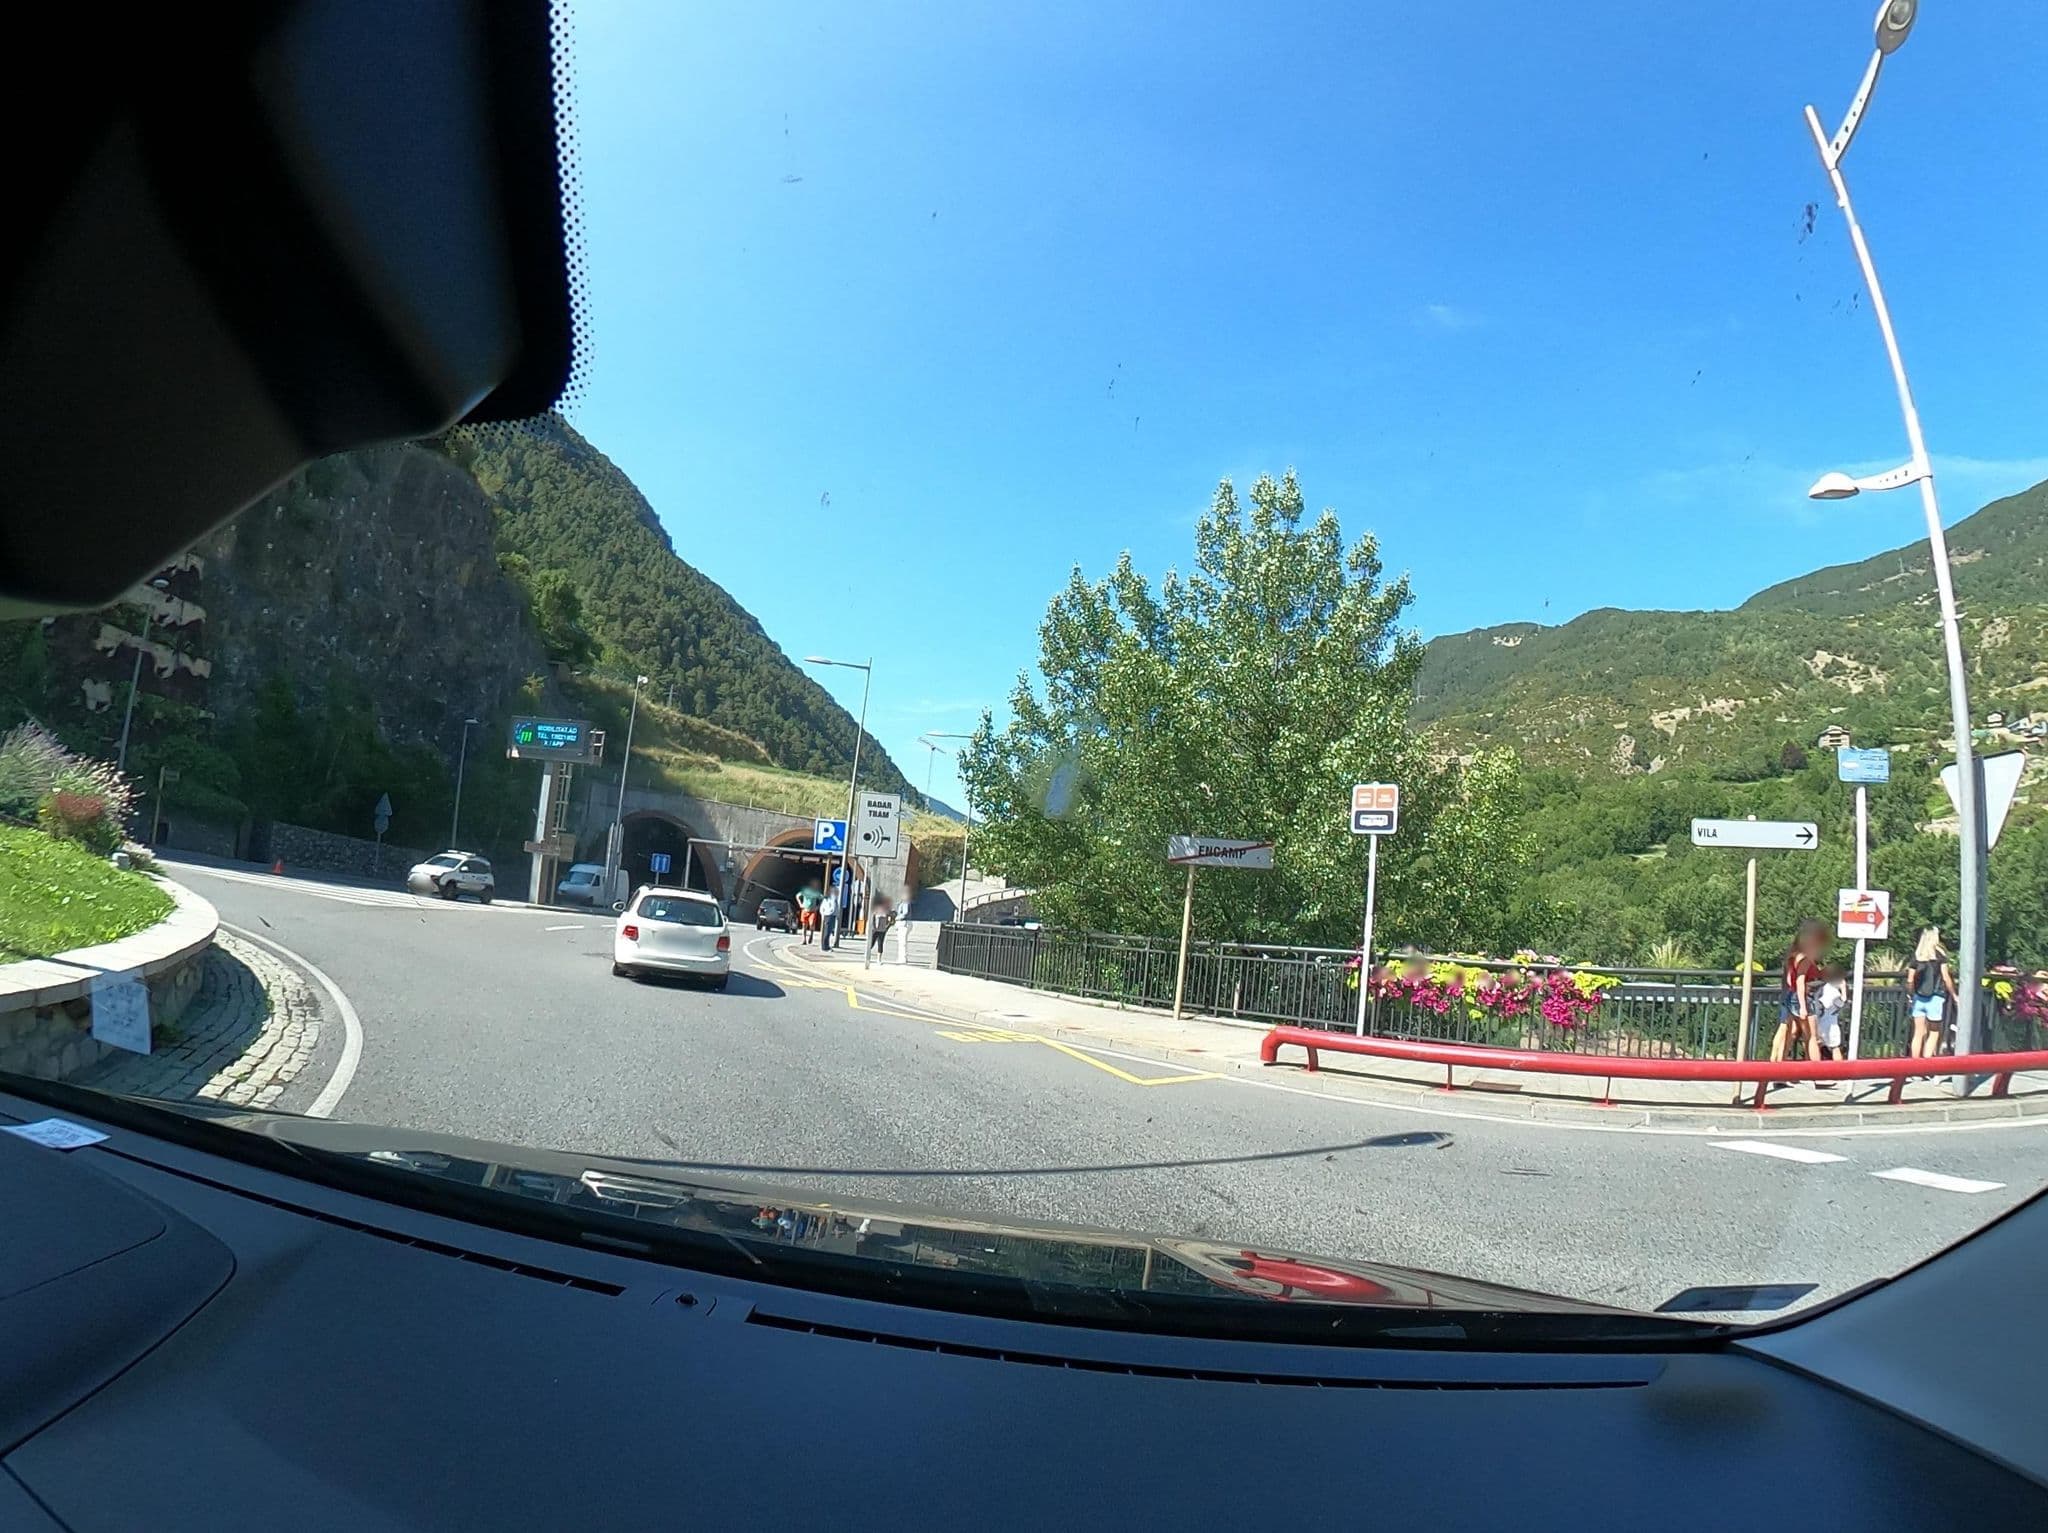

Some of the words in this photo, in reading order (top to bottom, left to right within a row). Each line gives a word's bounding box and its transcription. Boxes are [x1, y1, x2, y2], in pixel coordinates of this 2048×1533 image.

[867, 800, 892, 809] RADAR
[868, 810, 890, 818] TRAM
[816, 821, 836, 844] P
[1697, 827, 1718, 838] VILA
[1198, 845, 1247, 859] ENCAMP
